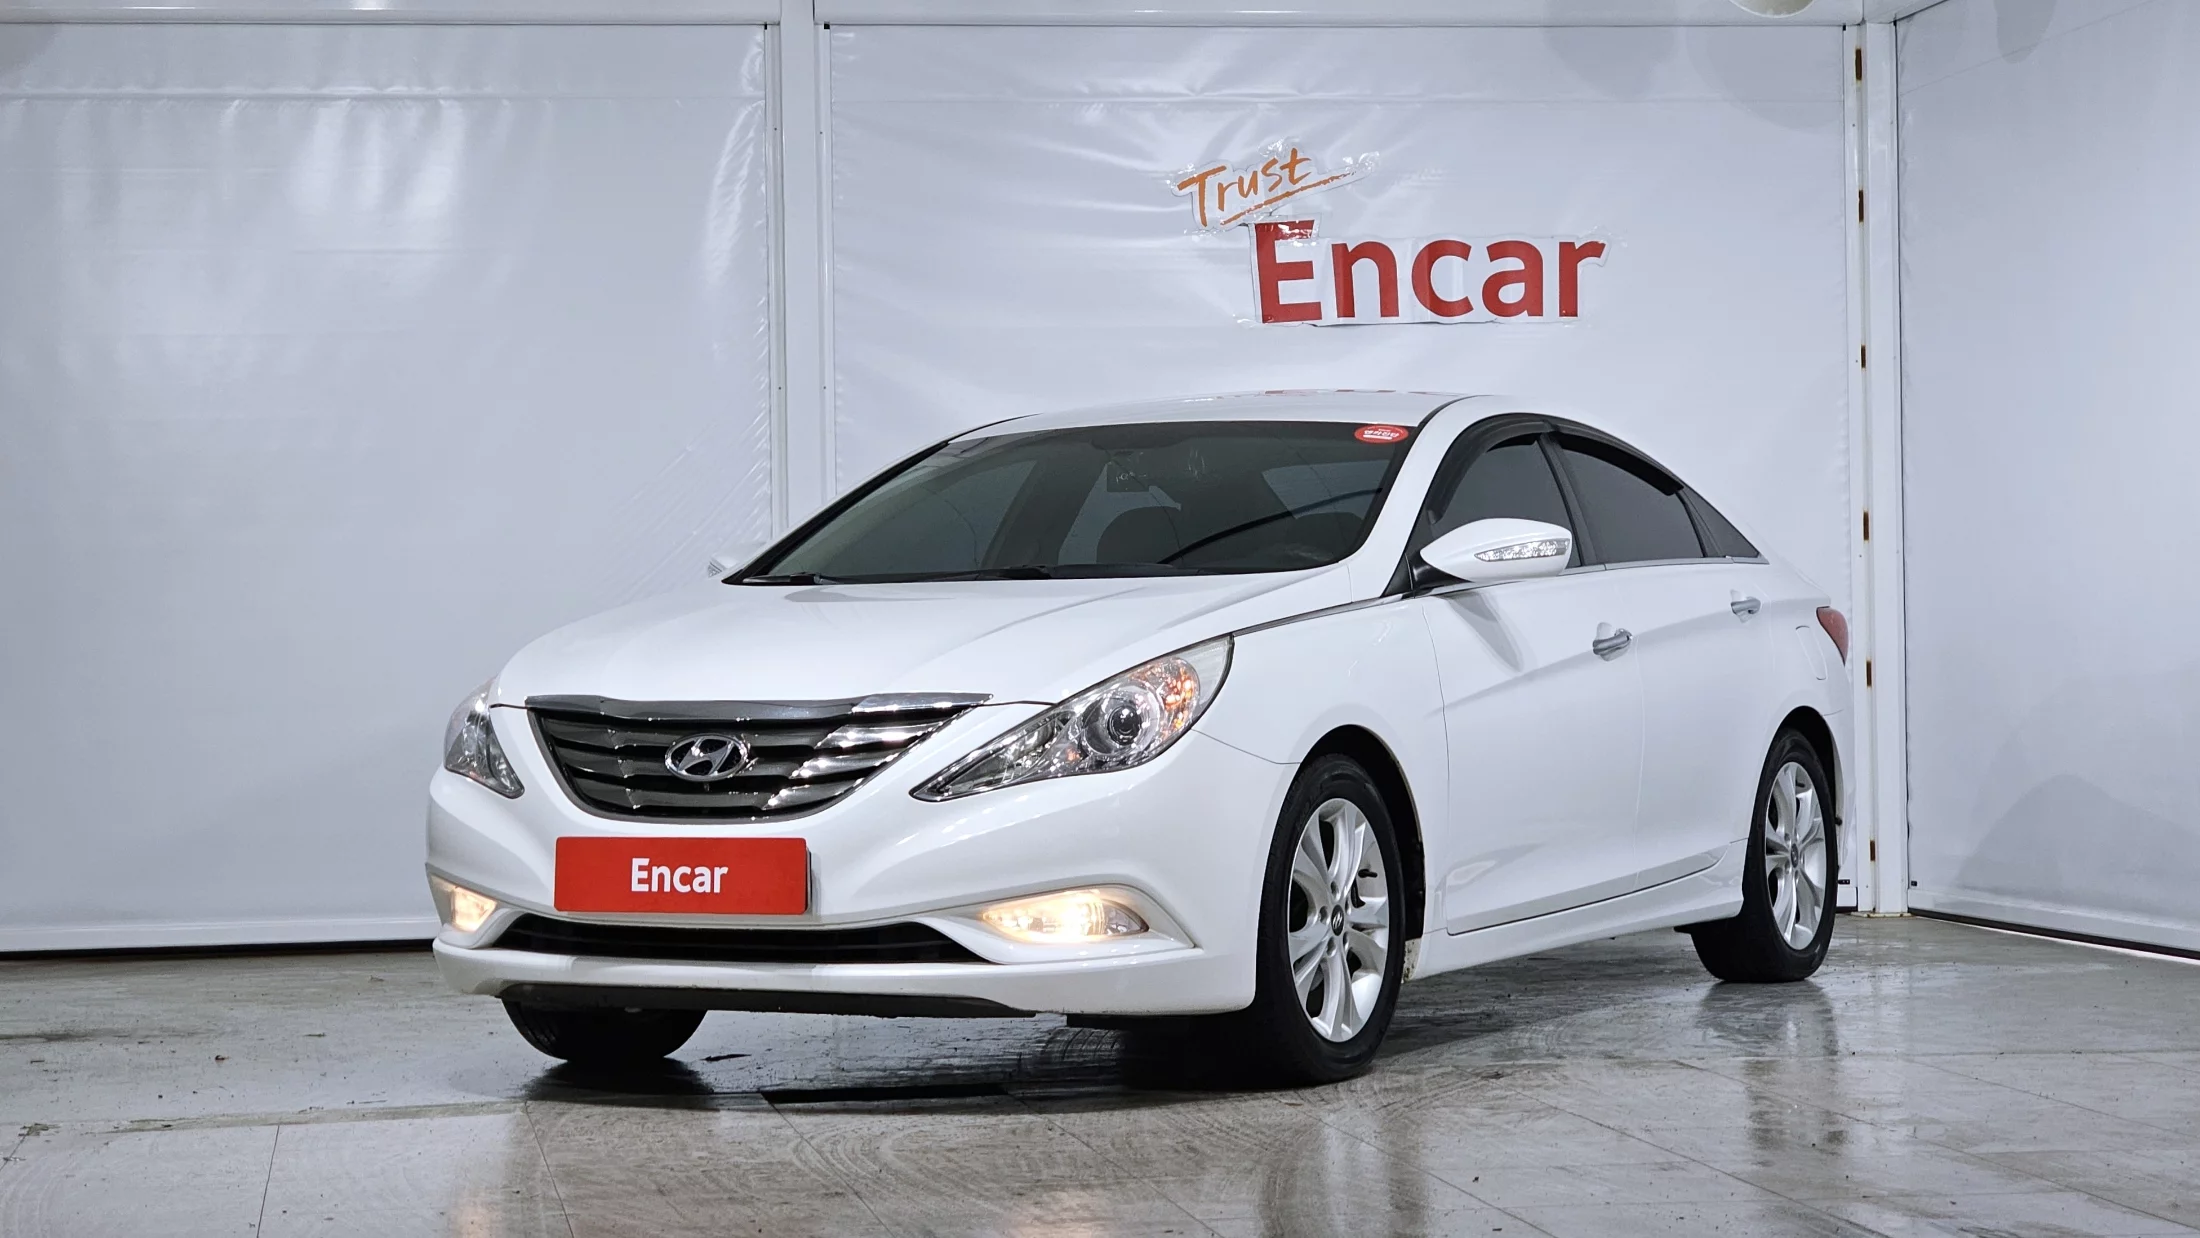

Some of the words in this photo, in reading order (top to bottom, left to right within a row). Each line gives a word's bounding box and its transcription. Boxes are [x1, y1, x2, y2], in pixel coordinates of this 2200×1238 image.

[1177, 147, 1312, 228] Trust
[1254, 219, 1607, 324] Encar
[630, 857, 729, 894] Encar
